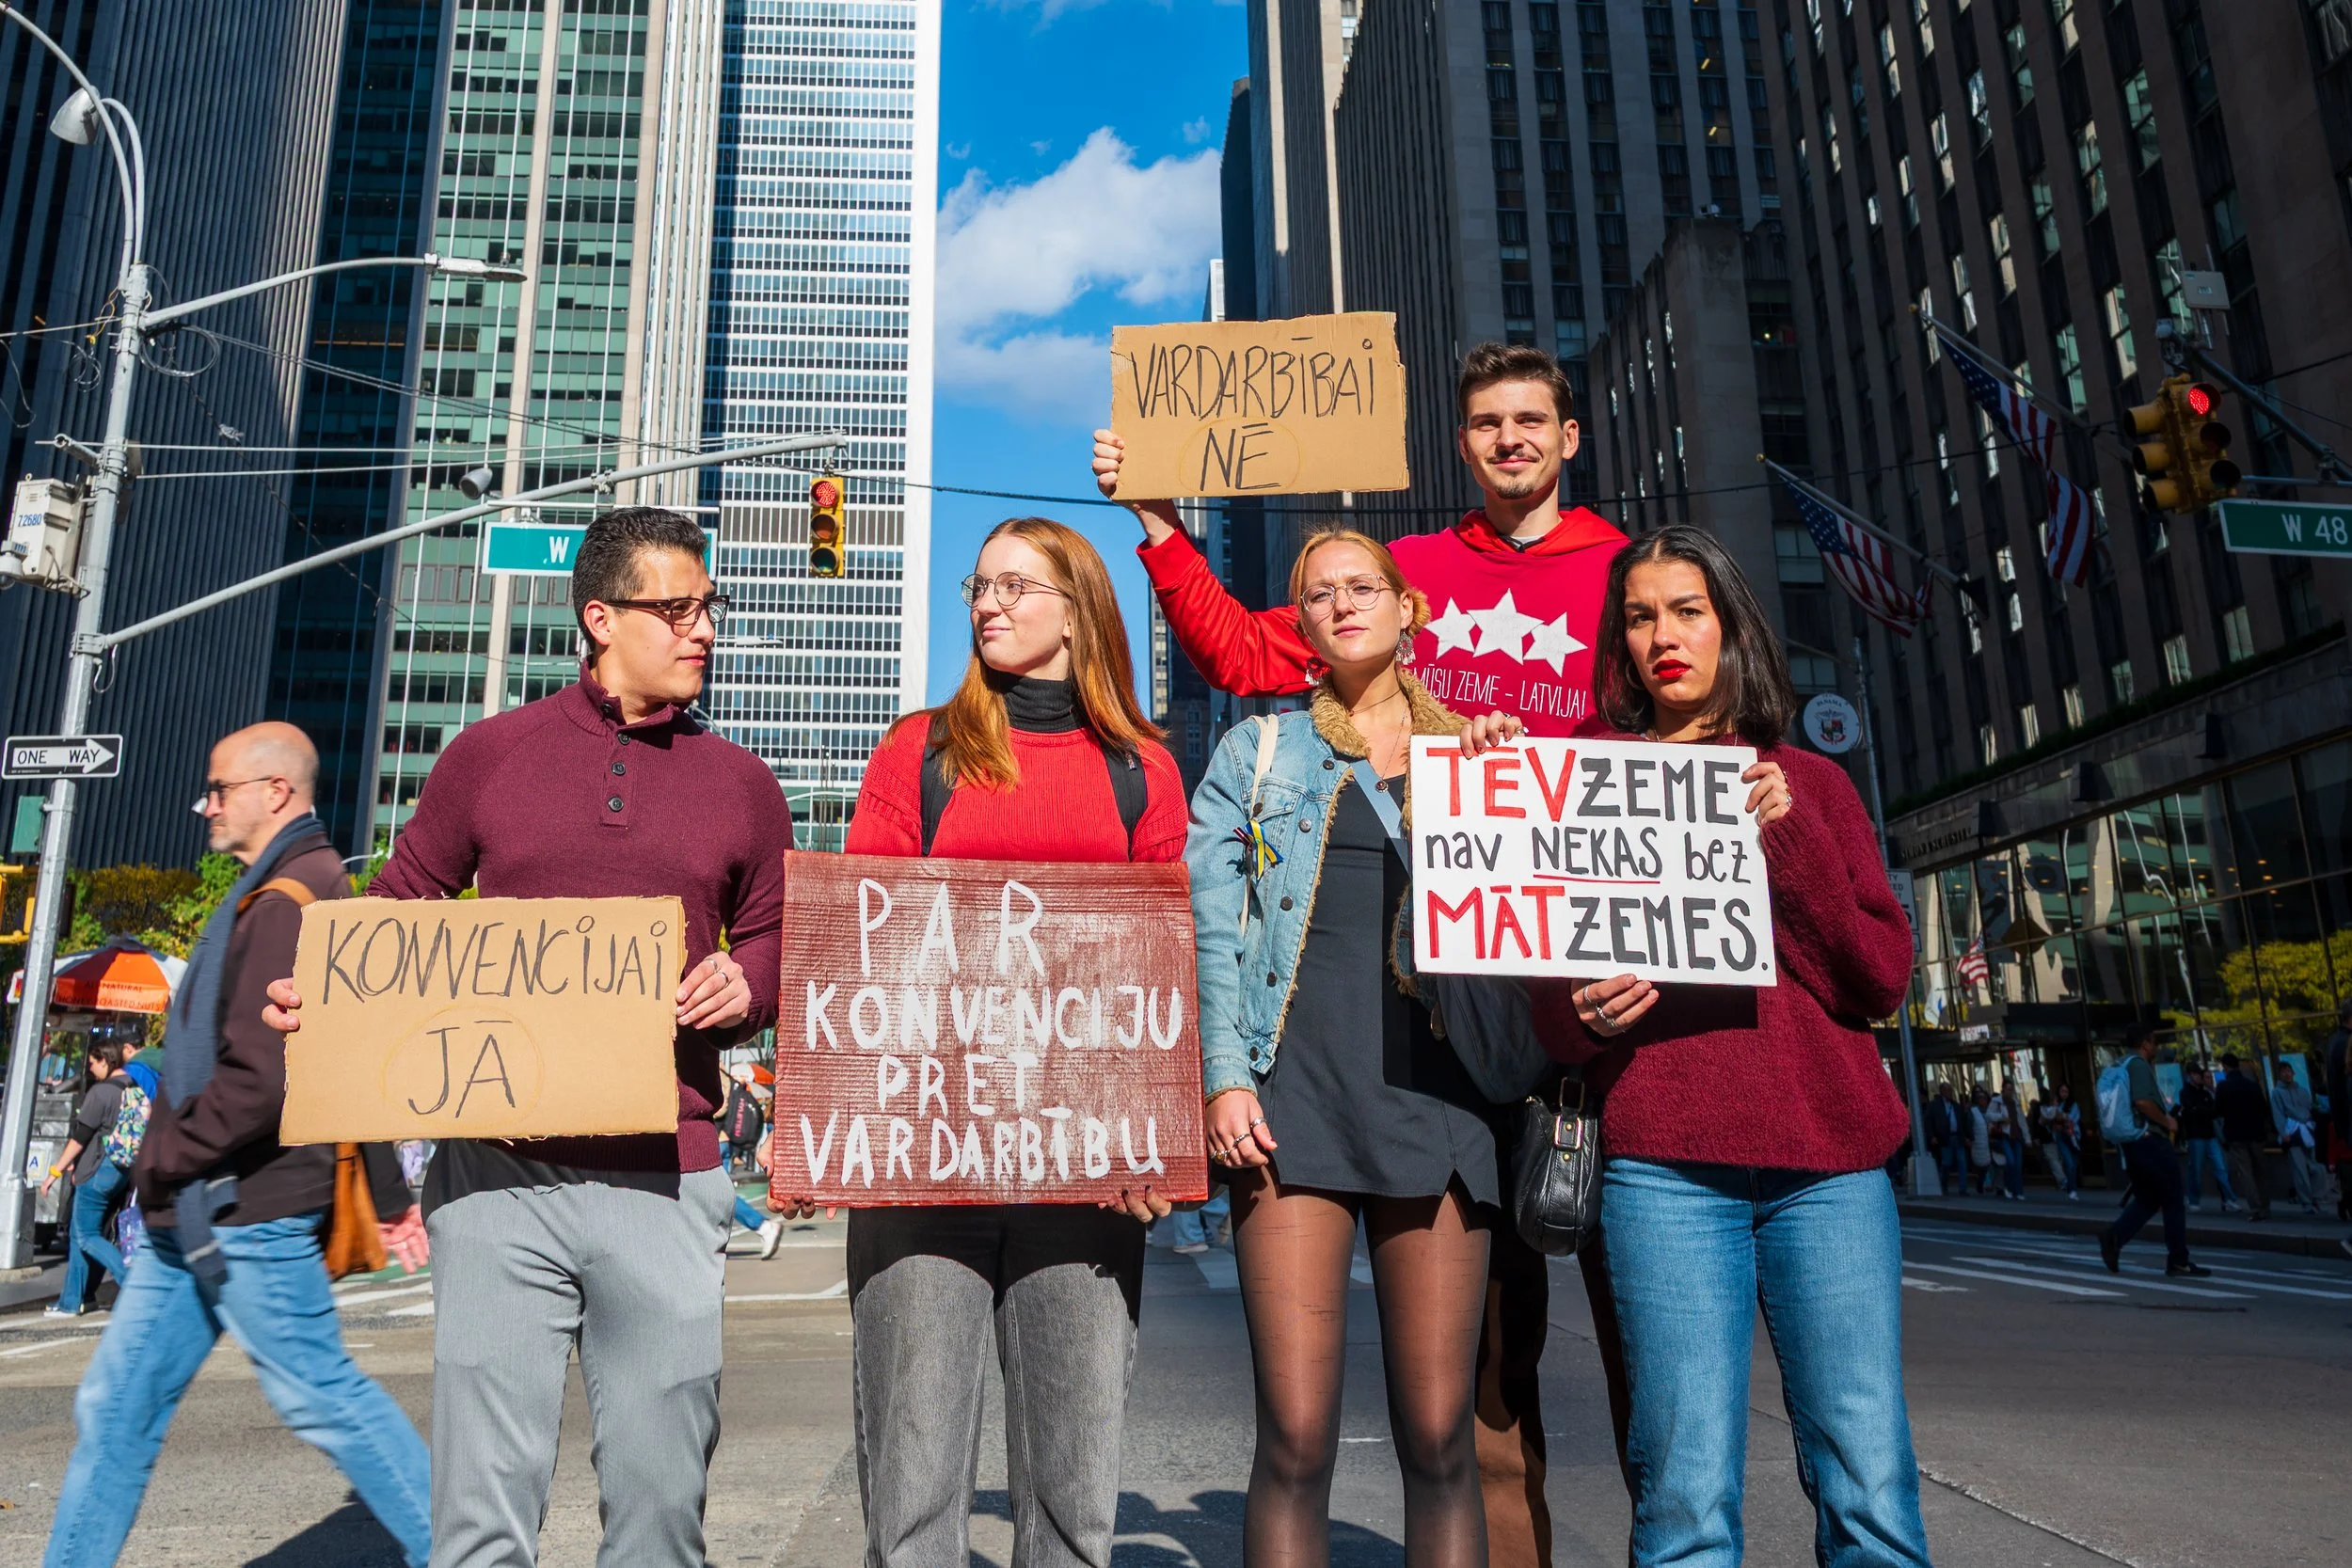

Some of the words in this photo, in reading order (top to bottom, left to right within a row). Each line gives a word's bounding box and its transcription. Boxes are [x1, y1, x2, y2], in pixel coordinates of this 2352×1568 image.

[1200, 423, 1281, 491] NĒ
[548, 536, 570, 564] W
[2281, 514, 2302, 542] W
[2314, 515, 2348, 545] 48
[1454, 670, 1501, 705] ZEME
[1519, 680, 1587, 721] LATVIJA!
[17, 750, 48, 765] ONE
[69, 749, 101, 764] WAY
[1426, 746, 1740, 825] TĒVZEME
[1425, 832, 1502, 872] nav
[1531, 826, 1663, 879] NEKAS
[1684, 832, 1752, 883] bez
[858, 878, 1046, 977] PAR
[1427, 884, 1769, 971] MĀTZEMES.
[805, 980, 1184, 1051] KONVENCIJU
[408, 1020, 516, 1117] JĀ
[877, 1052, 1039, 1119] PRET
[29, 1155, 39, 1167] A
